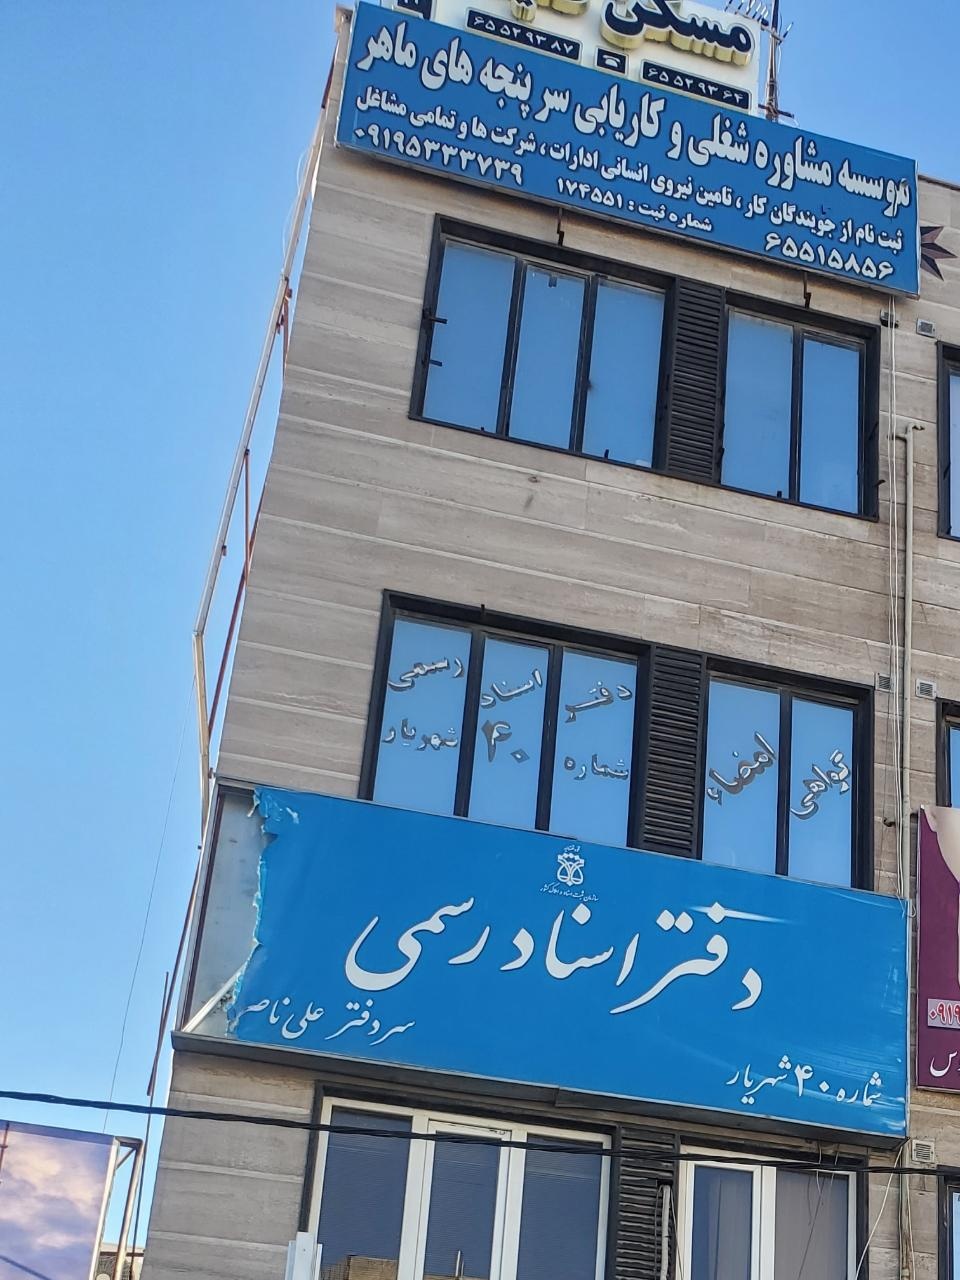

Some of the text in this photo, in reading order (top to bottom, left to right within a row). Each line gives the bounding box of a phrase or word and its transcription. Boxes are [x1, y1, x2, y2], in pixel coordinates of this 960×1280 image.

[356, 21, 417, 71] ماهر
[420, 37, 473, 91] های
[573, 83, 666, 148] کاریابی
[666, 120, 683, 160] و
[687, 114, 750, 166] شغلی
[356, 86, 904, 255] ثبت نام از جویندگان کار تامین نیروی انسانی ادارات شرکت ها و تمامی مشاغل
[754, 136, 832, 190] مشاوره
[556, 176, 712, 232] شماره ثبت ۱۷۴۵۵۱
[764, 231, 894, 281] ۶۵۵۱۵۸۵۶
[386, 654, 465, 692] رسمی
[480, 668, 544, 709] اسناد
[343, 895, 764, 1014] دفتر اسناد رسمی
[281, 1001, 325, 1040] علی
[725, 1054, 793, 1105] شهریار
[835, 1070, 882, 1107] شماره
